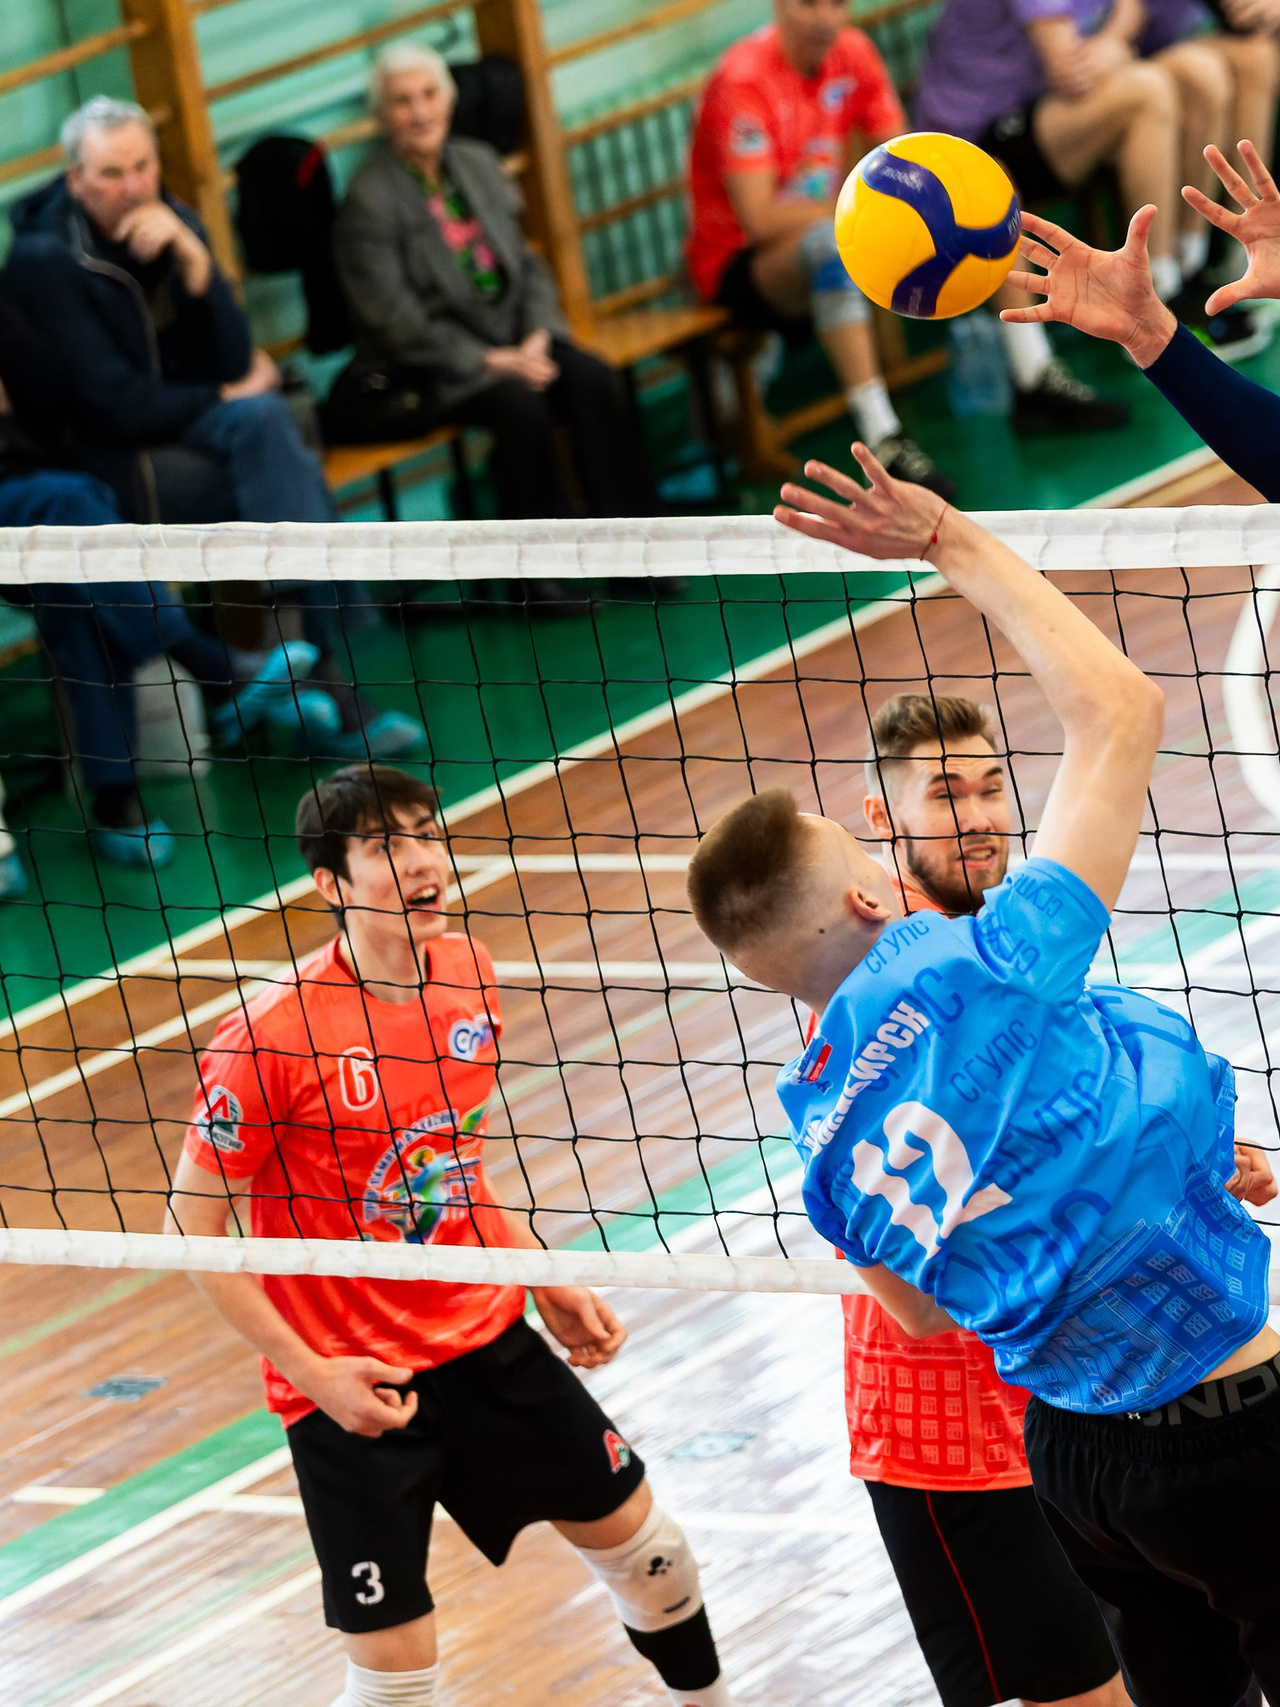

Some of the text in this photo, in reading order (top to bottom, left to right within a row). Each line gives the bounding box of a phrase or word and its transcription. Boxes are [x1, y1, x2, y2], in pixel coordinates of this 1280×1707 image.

[864, 919, 930, 975] СГУПС
[338, 1046, 380, 1111] 6
[951, 1019, 1038, 1103] СГУПС
[351, 1561, 385, 1606] 3
